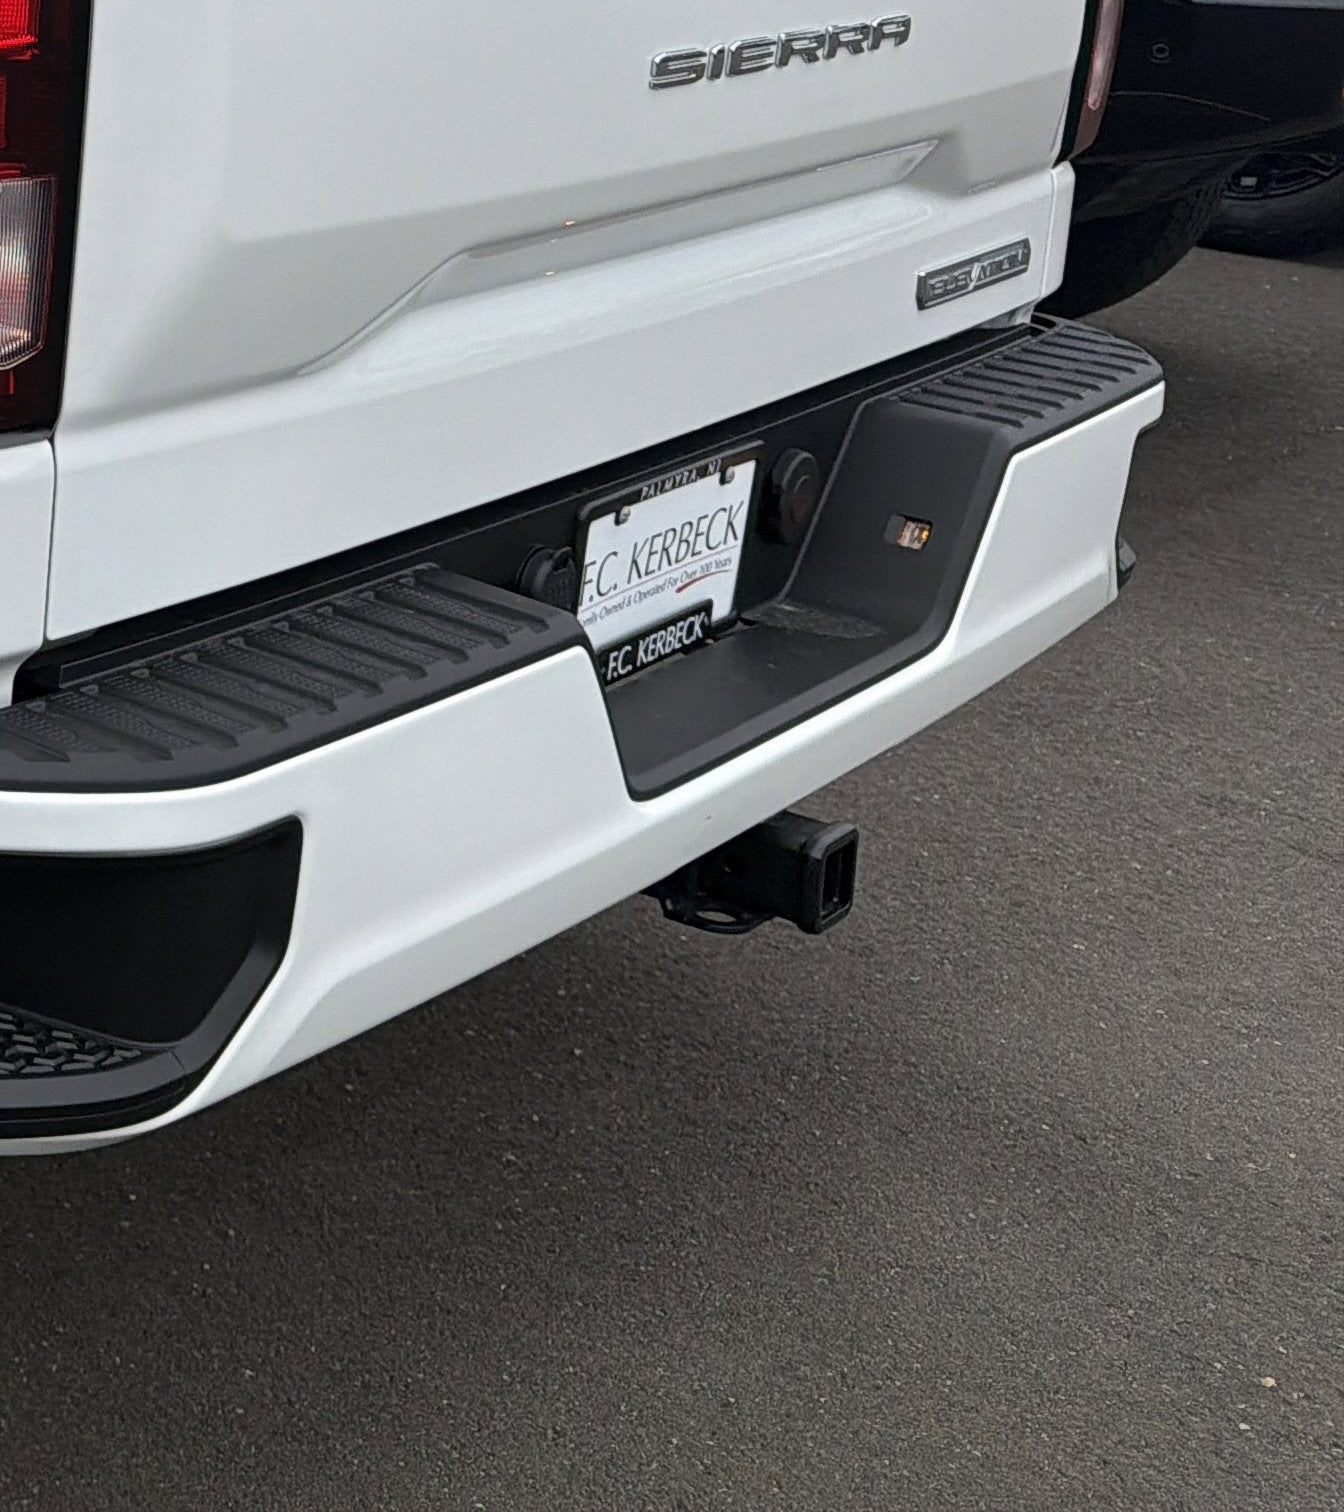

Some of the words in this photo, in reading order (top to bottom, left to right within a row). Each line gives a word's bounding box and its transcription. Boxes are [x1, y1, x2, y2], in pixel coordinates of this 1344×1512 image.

[649, 14, 912, 89] SIERRA
[582, 550, 618, 604] F.C.
[627, 500, 745, 584] KERBECK
[606, 645, 632, 681] F.C.
[636, 611, 705, 668] KERBECK
